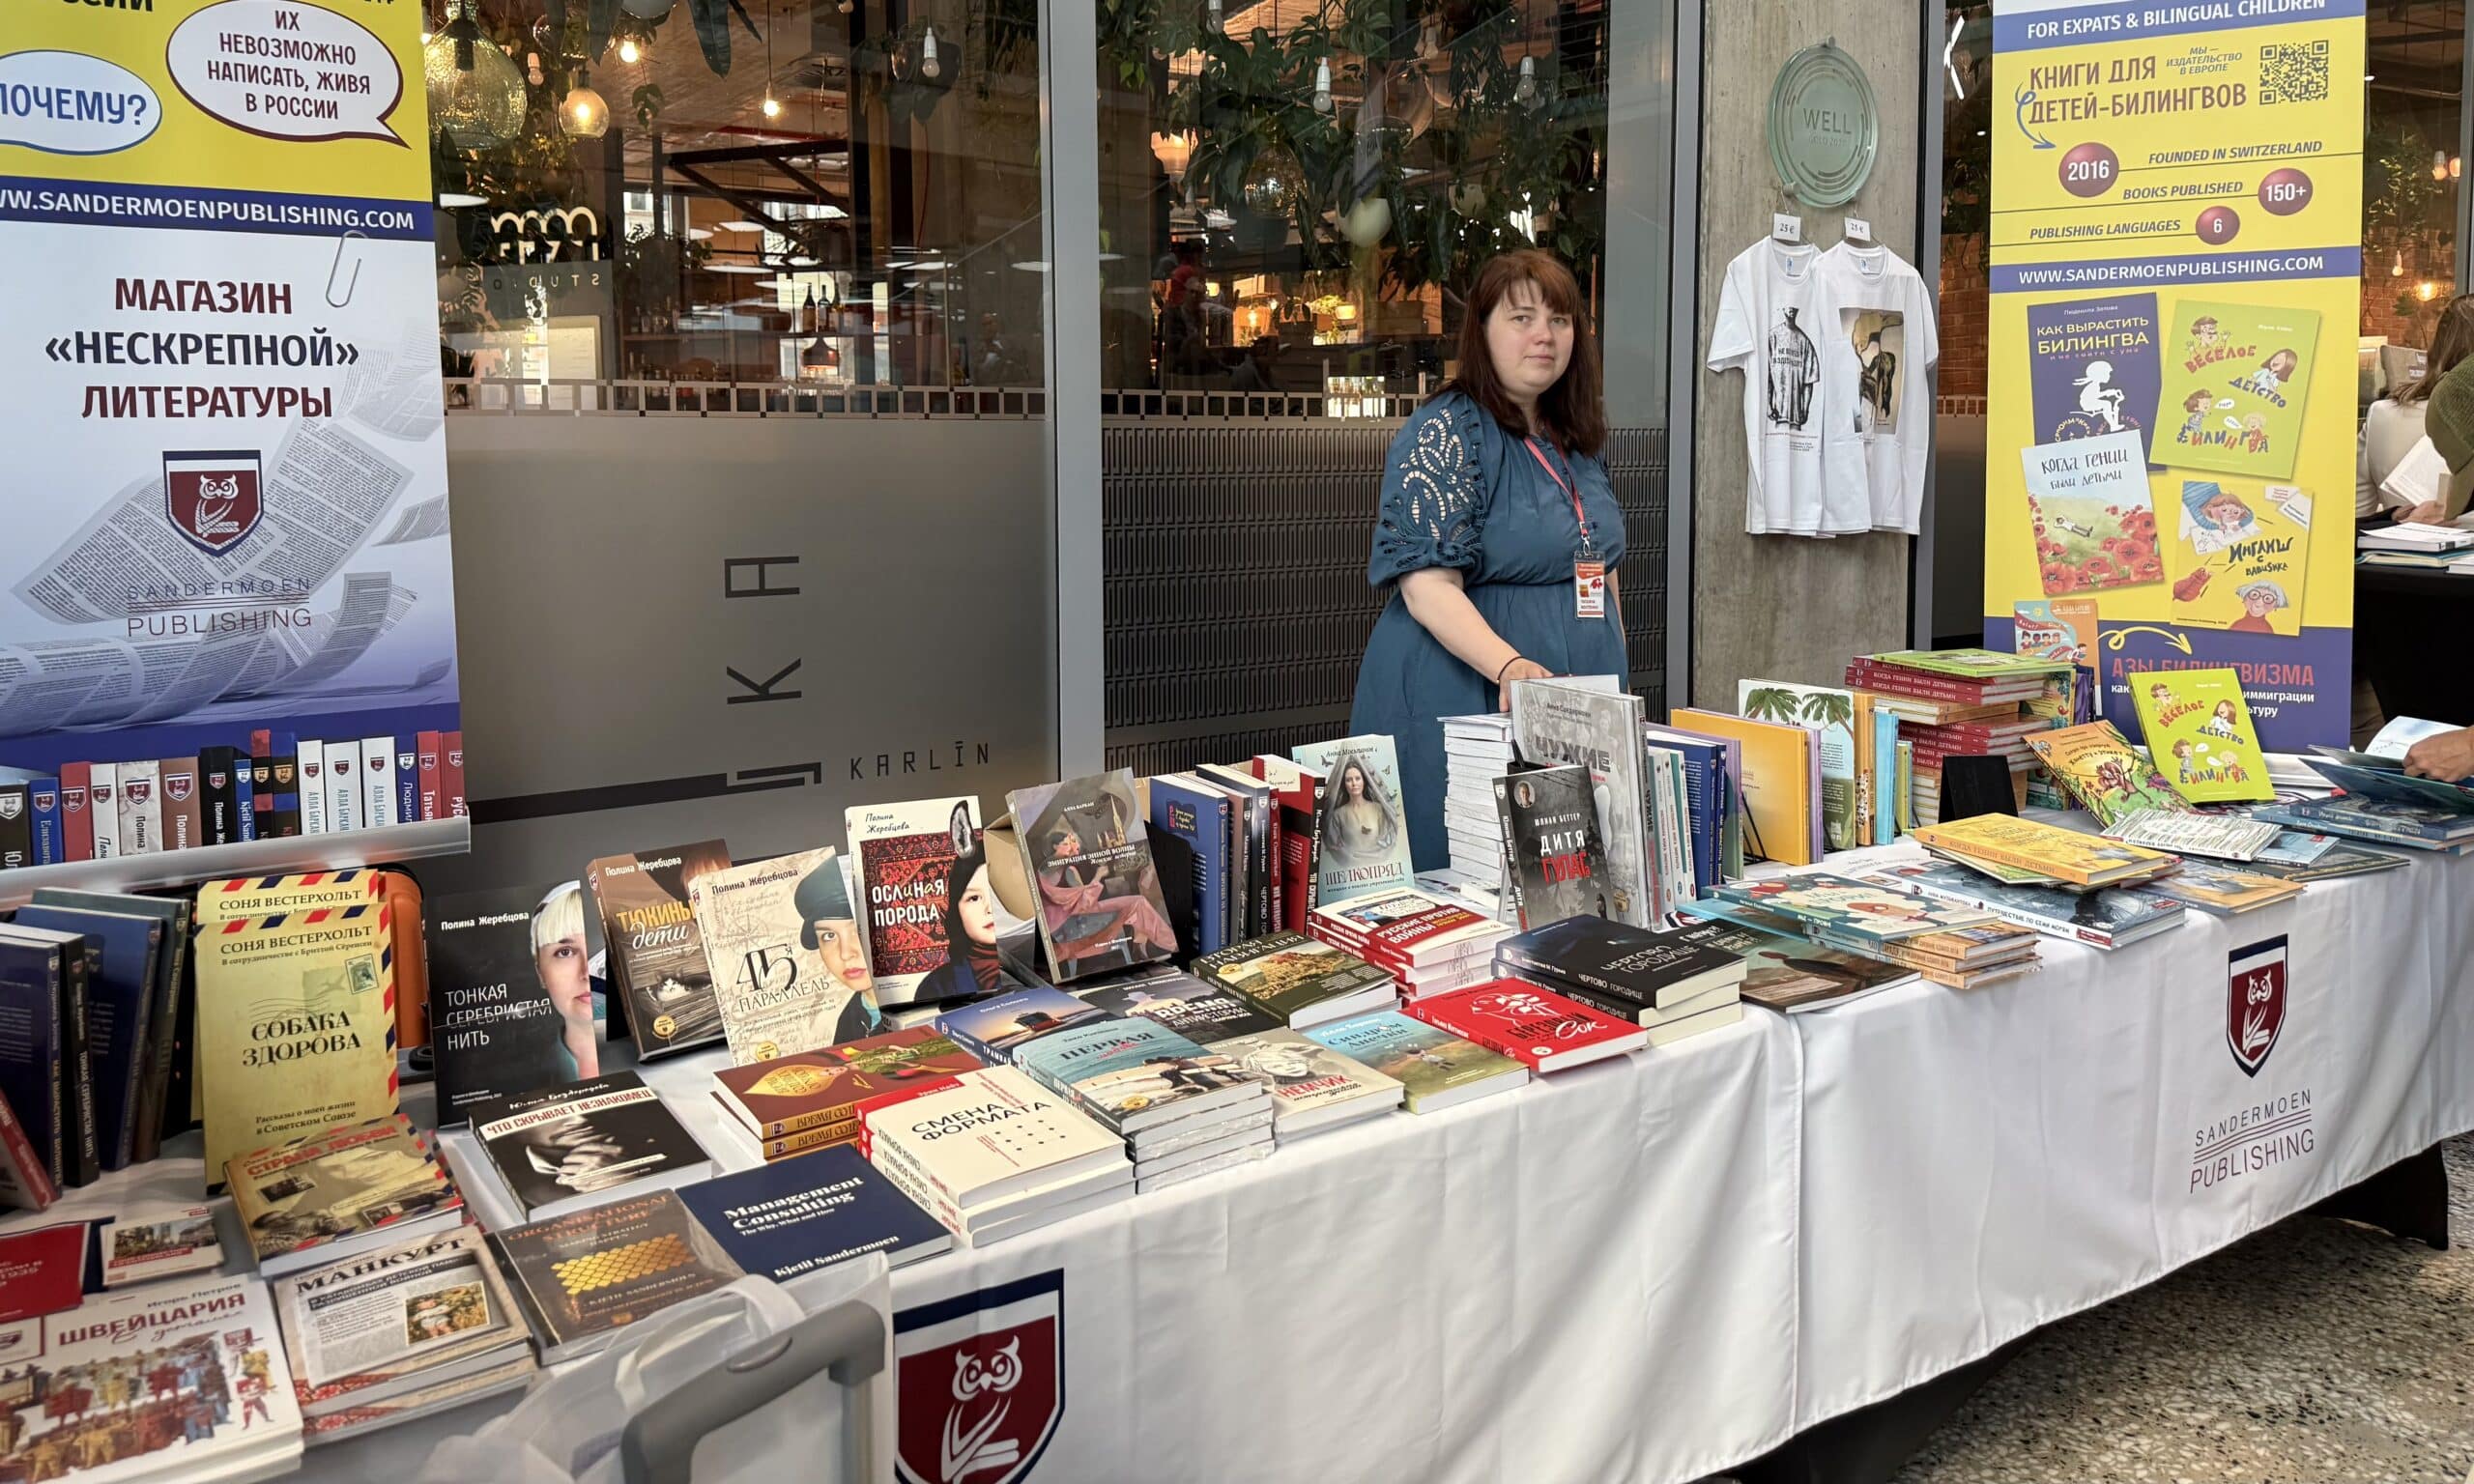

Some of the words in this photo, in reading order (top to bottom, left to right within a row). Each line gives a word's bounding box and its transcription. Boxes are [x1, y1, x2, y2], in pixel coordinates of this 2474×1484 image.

[274, 10, 301, 32] ИХ
[2028, 22, 2058, 40] FOR
[2062, 14, 2122, 36] EXPATS
[2125, 13, 2139, 28] &
[2143, 2, 2234, 27] BILINGUAL
[2238, 0, 2326, 17] CHILDREN
[219, 32, 357, 66] НЕВОЗМОЖНО
[2166, 51, 2242, 68] ИЗДАТЕЛЬСТВО
[2190, 46, 2207, 56] МЫ
[207, 60, 310, 92] НАПИСАТЬ,
[316, 71, 371, 95] ЖИВЯ
[2030, 60, 2101, 91] КНИГИ
[2108, 56, 2156, 83] ДЛЯ
[2180, 66, 2188, 75] В
[2189, 63, 2229, 74] ЕВРОПЕ
[245, 95, 259, 113] В
[265, 95, 339, 120] РОССИИ
[2028, 83, 2247, 125] ДЕТЕЙ-БИЛИНГВОВ
[1802, 107, 1852, 135] WELL
[2067, 160, 2110, 183] 2016
[2148, 149, 2209, 165] FOUNDED
[2213, 148, 2226, 160] IN
[2229, 140, 2322, 159] SWITZERLAND
[2123, 187, 2168, 201] BOOKS
[2171, 182, 2244, 197] PUBLISHED
[2265, 184, 2307, 203] 150+
[1779, 222, 1789, 232] 25
[2029, 224, 2104, 241] PUBLISHING
[2107, 219, 2181, 237] LANGUAGES
[2213, 218, 2223, 234] 6
[2019, 255, 2324, 285] WWW.SANDERMOENPUBLISHING.COM
[114, 277, 293, 315] МАГАЗИН
[2036, 326, 2063, 337] КАК
[2066, 317, 2149, 333] ВЫРАСТИТЬ
[44, 327, 360, 367] «НЕСКРЕПНОЙ»
[2038, 331, 2150, 355] БИЛИНГВА
[82, 385, 333, 419] ЛИТЕРАТУРЫ
[2228, 376, 2287, 409] ДЕТСТВО
[127, 577, 311, 601] SANDERMOEN
[127, 608, 312, 638] PUBLISHING
[215, 801, 224, 831] Полина
[135, 815, 146, 849] Полина
[176, 814, 187, 850] Полина
[1540, 829, 1586, 857] ДИТЯ
[605, 865, 635, 877] Полина
[637, 855, 682, 872] Жеребцова
[711, 881, 746, 896] Полина
[748, 869, 799, 887] Жеребцова
[219, 898, 261, 910] СОНЯ
[265, 889, 362, 907] ВЕСТЕРХОЛЬТ
[441, 917, 475, 931] Полина
[477, 911, 530, 929] Жеребцова
[874, 902, 940, 928] ПОРОДА
[1375, 917, 1424, 939] РУССКИЕ
[220, 940, 266, 955] СОНЯ
[270, 926, 373, 950] ВЕСТЕРХОЛЬТ
[631, 922, 689, 951] дети
[1388, 924, 1436, 945] ВОЙНЫ
[1600, 945, 1672, 971] ЧЕРТОВО
[1620, 944, 1701, 974] ГОРОДИЩЕ
[445, 984, 508, 1008] ТОНКАЯ
[1568, 991, 1596, 1009] ЧЕРТОВО
[1578, 973, 1608, 989] ЧЕРТОВО
[1609, 983, 1643, 1000] ГОРОДИЩЕ
[250, 1010, 352, 1042] СОБАКА
[1555, 1019, 1608, 1041] Сок
[243, 1033, 361, 1070] ЗДОРОВА
[446, 1031, 490, 1051] НИТЬ
[1060, 1031, 1157, 1061] ПЕРВАЯ
[263, 1118, 321, 1134] Советском
[323, 1111, 357, 1123] Союзе
[486, 1123, 513, 1135] ЧТО
[514, 1106, 576, 1128] СКРЫВАЕТ
[578, 1089, 653, 1111] НЕЗНАКОМЕЦ
[796, 1110, 833, 1129] ВРЕМЯ
[911, 1102, 1005, 1133] СМЕНА
[921, 1101, 1053, 1141] ФОРМАТА
[2195, 1088, 2313, 1148] SANDERMOEN
[797, 1130, 833, 1148] ВРЕМЯ
[2189, 1127, 2315, 1195] PUBLISHING
[724, 1176, 865, 1220] Management
[733, 1191, 856, 1230] Consulting
[739, 1227, 757, 1237] The
[780, 1216, 800, 1227] What
[801, 1212, 818, 1220] and
[295, 1238, 465, 1295] МАНКУРТ
[774, 1259, 815, 1277] Kjetil
[815, 1235, 901, 1266] Sandermoen
[59, 1292, 246, 1347] ШВЕЙЦАРИЯ
